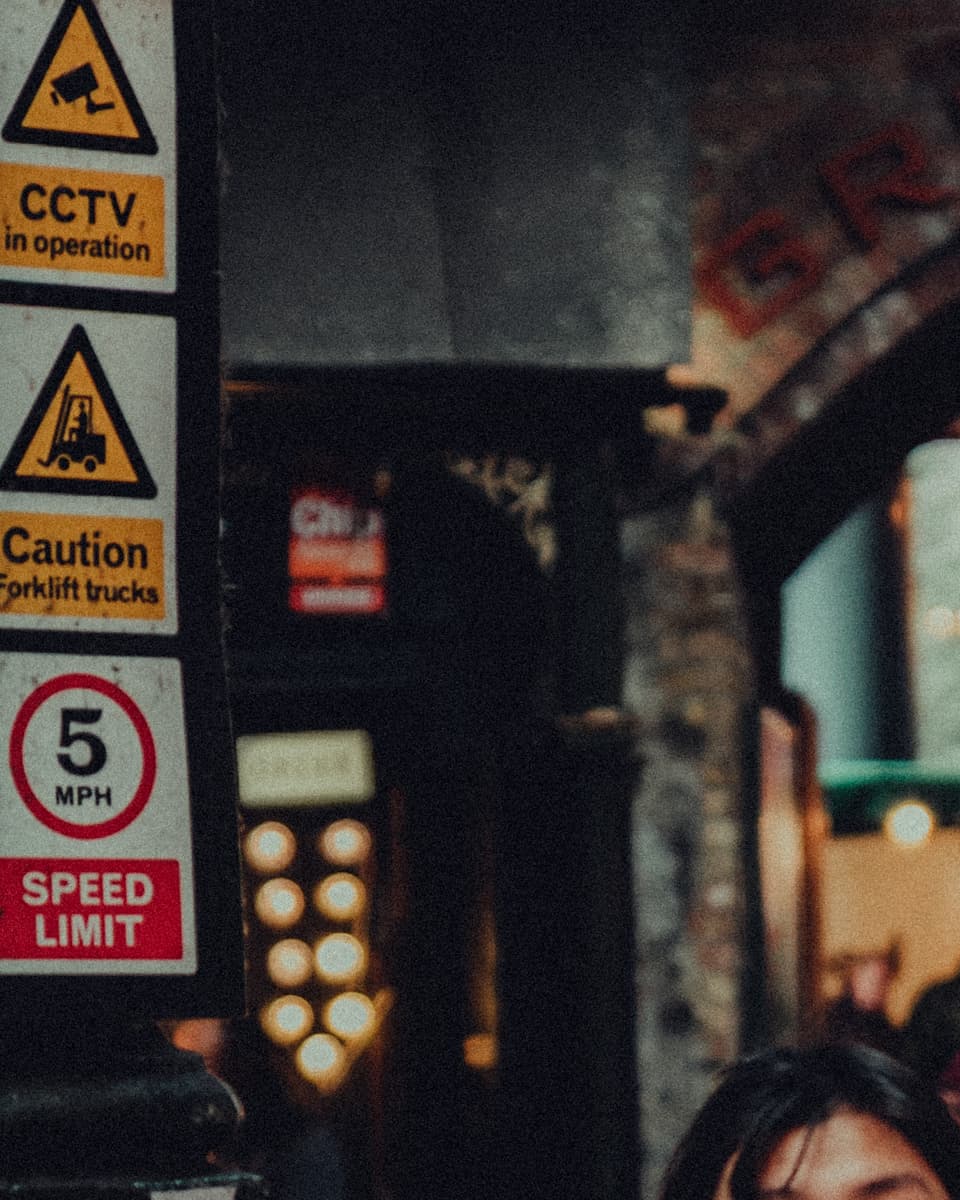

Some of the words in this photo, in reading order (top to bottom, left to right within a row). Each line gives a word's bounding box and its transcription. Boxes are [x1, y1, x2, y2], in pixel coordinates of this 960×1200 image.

[20, 183, 136, 227] CCTV
[5, 227, 27, 252] in
[34, 233, 150, 261] operation
[3, 526, 148, 569] Caution
[86, 579, 159, 604] trucks
[56, 708, 107, 776] 5
[55, 786, 112, 806] MPH
[22, 871, 154, 906] SPEED
[35, 914, 144, 948] LIMIT
